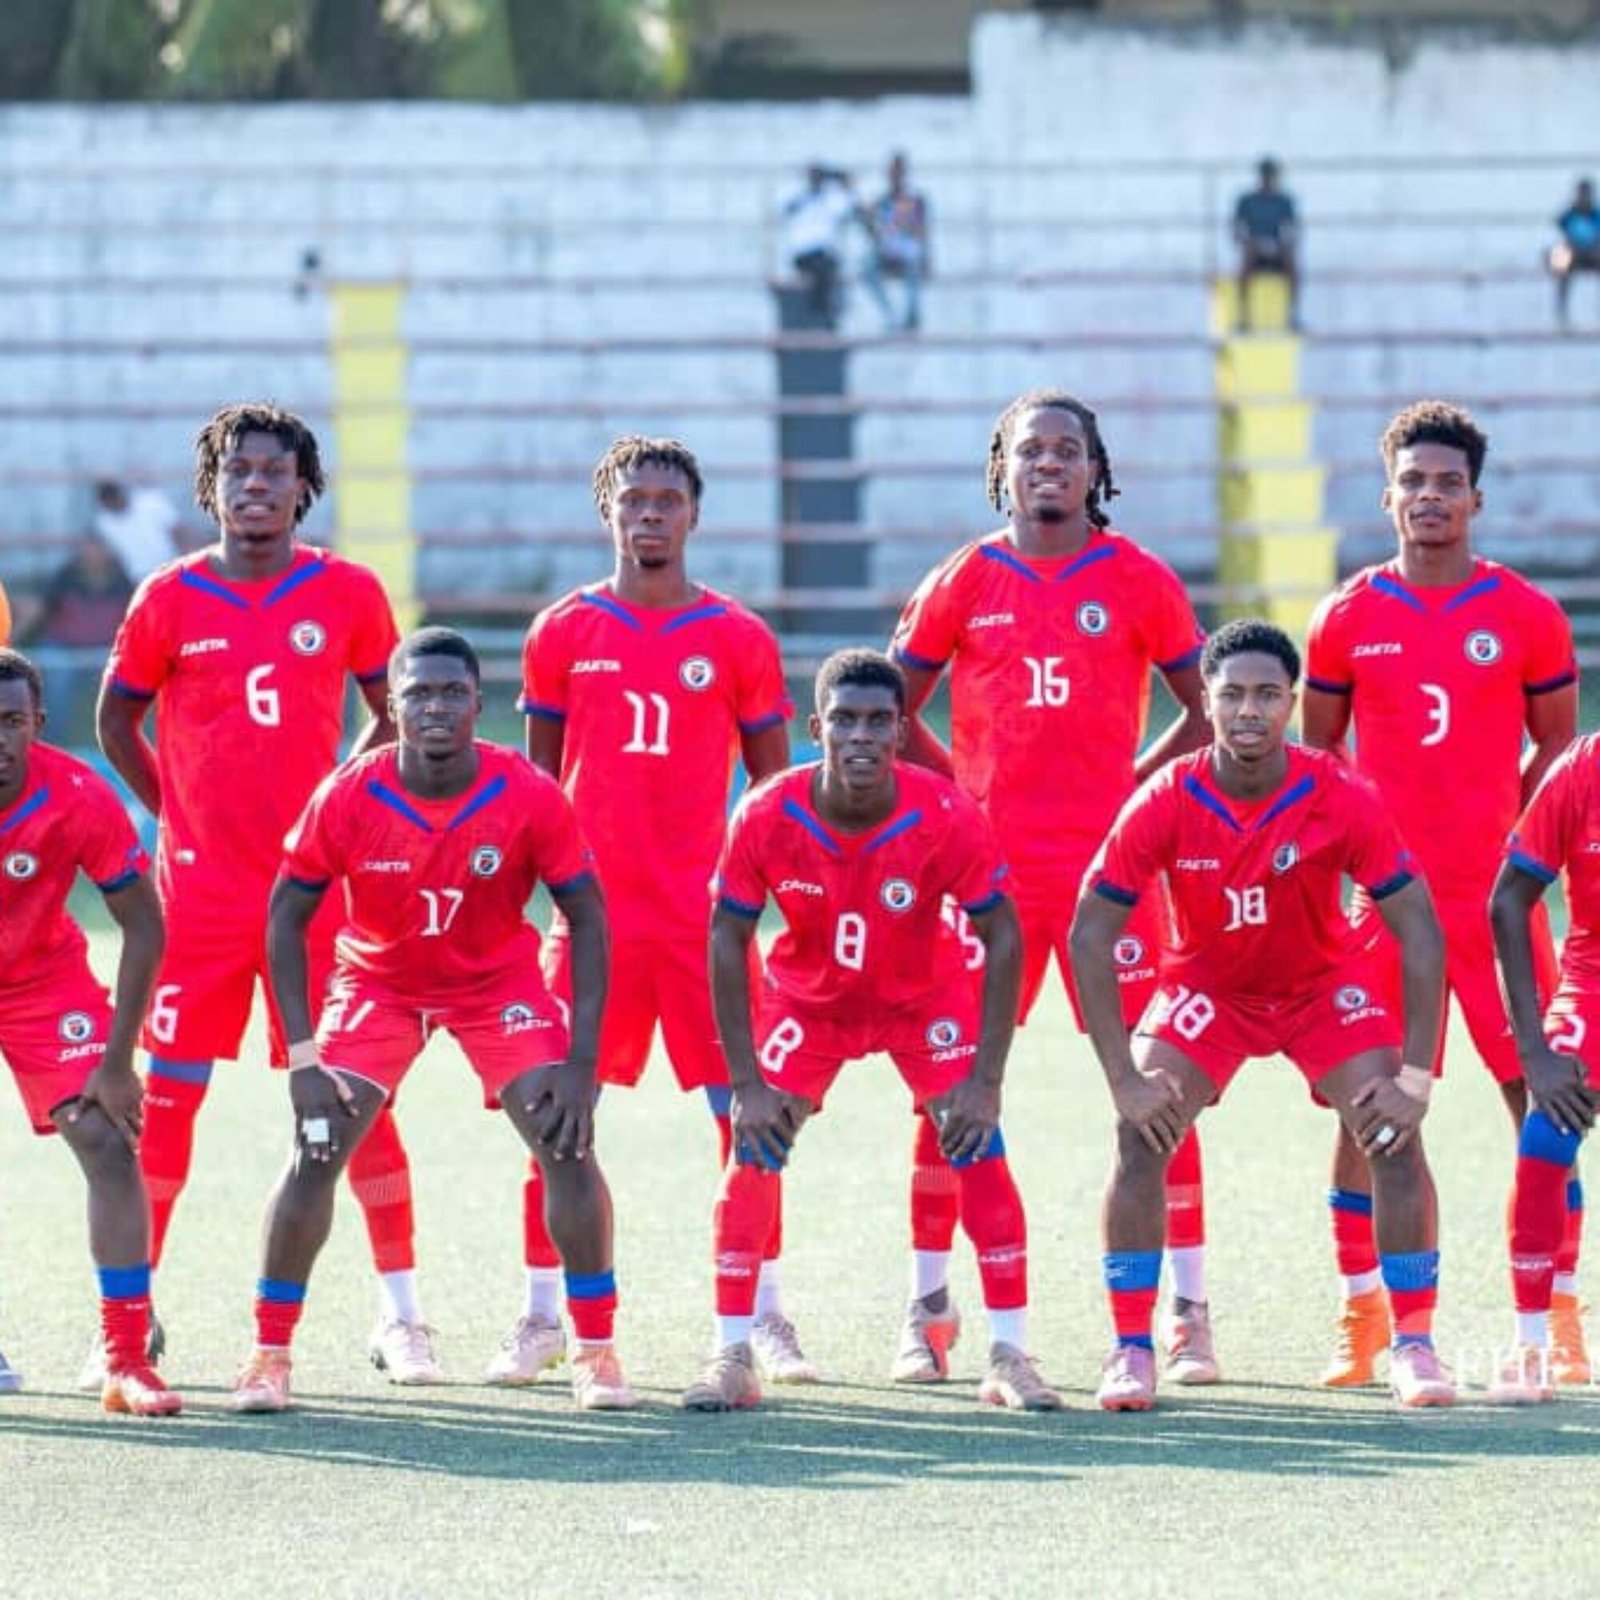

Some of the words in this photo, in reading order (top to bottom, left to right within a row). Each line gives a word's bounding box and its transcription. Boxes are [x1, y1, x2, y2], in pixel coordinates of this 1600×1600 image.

[246, 663, 281, 726] 6
[1023, 656, 1070, 707] 15
[622, 690, 670, 756] 11
[1420, 683, 1450, 746] 3
[418, 887, 464, 936] 17
[1224, 885, 1268, 931] 18
[835, 912, 867, 971] 8
[152, 984, 182, 1044] 6
[760, 1016, 804, 1073] 8
